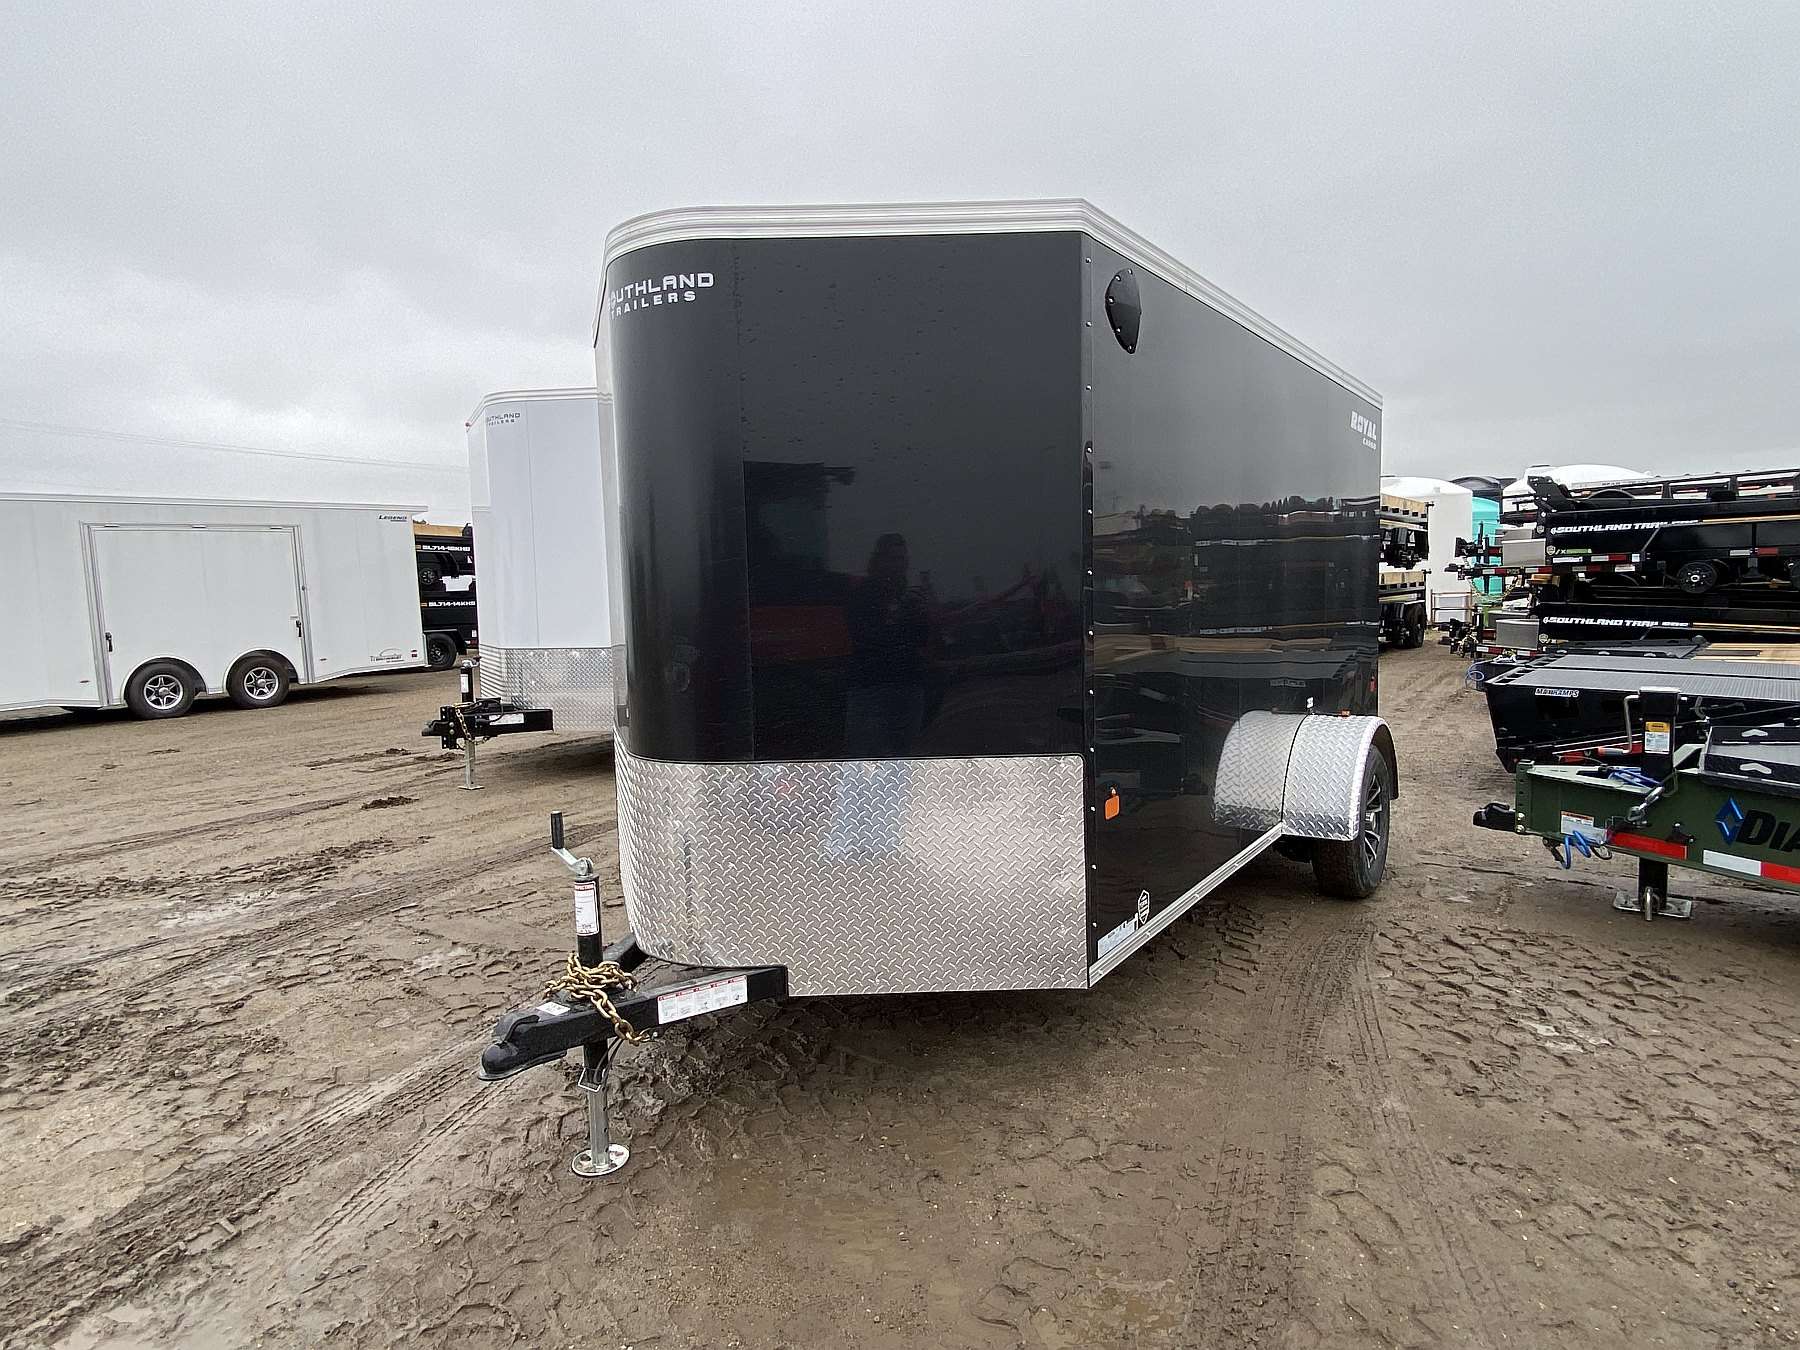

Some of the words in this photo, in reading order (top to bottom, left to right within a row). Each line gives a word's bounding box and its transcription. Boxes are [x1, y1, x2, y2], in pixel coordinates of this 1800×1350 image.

[1350, 410, 1377, 441] ROYAL
[1556, 522, 1633, 534] SOUTHLAND
[1547, 616, 1624, 627] SOUTHLAND
